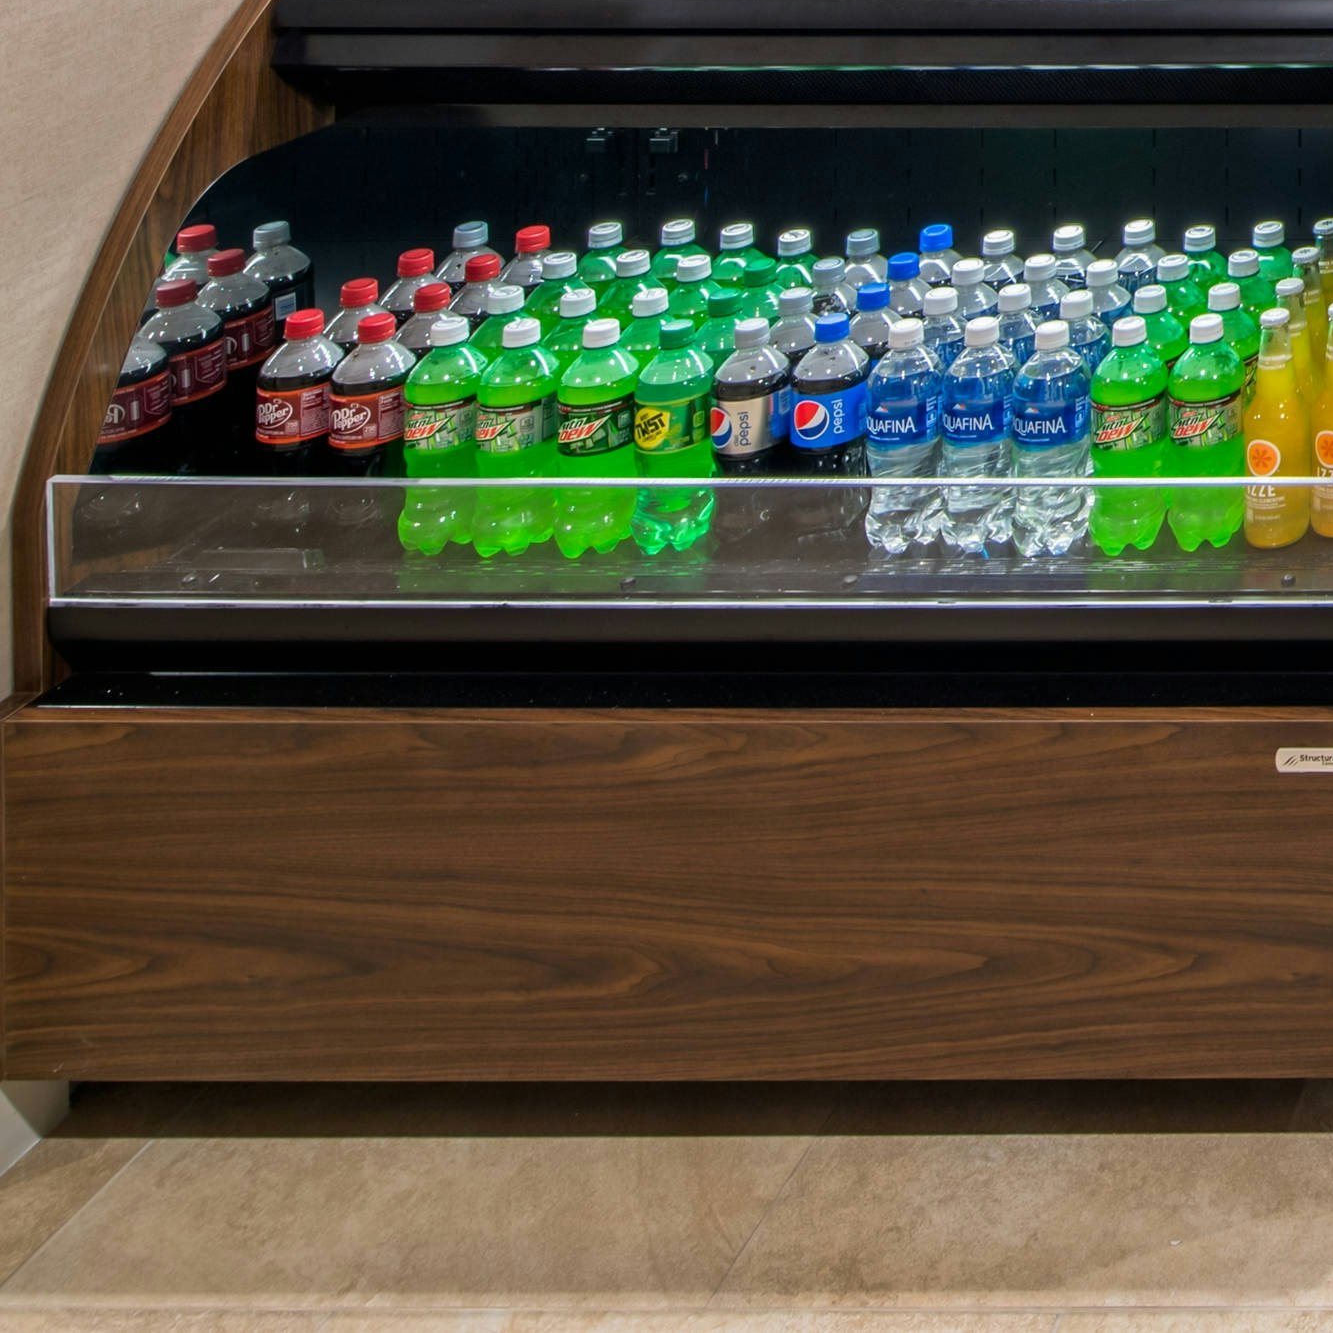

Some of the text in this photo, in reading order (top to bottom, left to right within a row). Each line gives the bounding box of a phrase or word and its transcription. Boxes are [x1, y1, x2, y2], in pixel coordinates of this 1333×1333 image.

[738, 411, 751, 447] pepsi
[831, 399, 845, 434] pepsi
[867, 416, 916, 435] QUAFINA
[943, 414, 993, 433] QUAFINA
